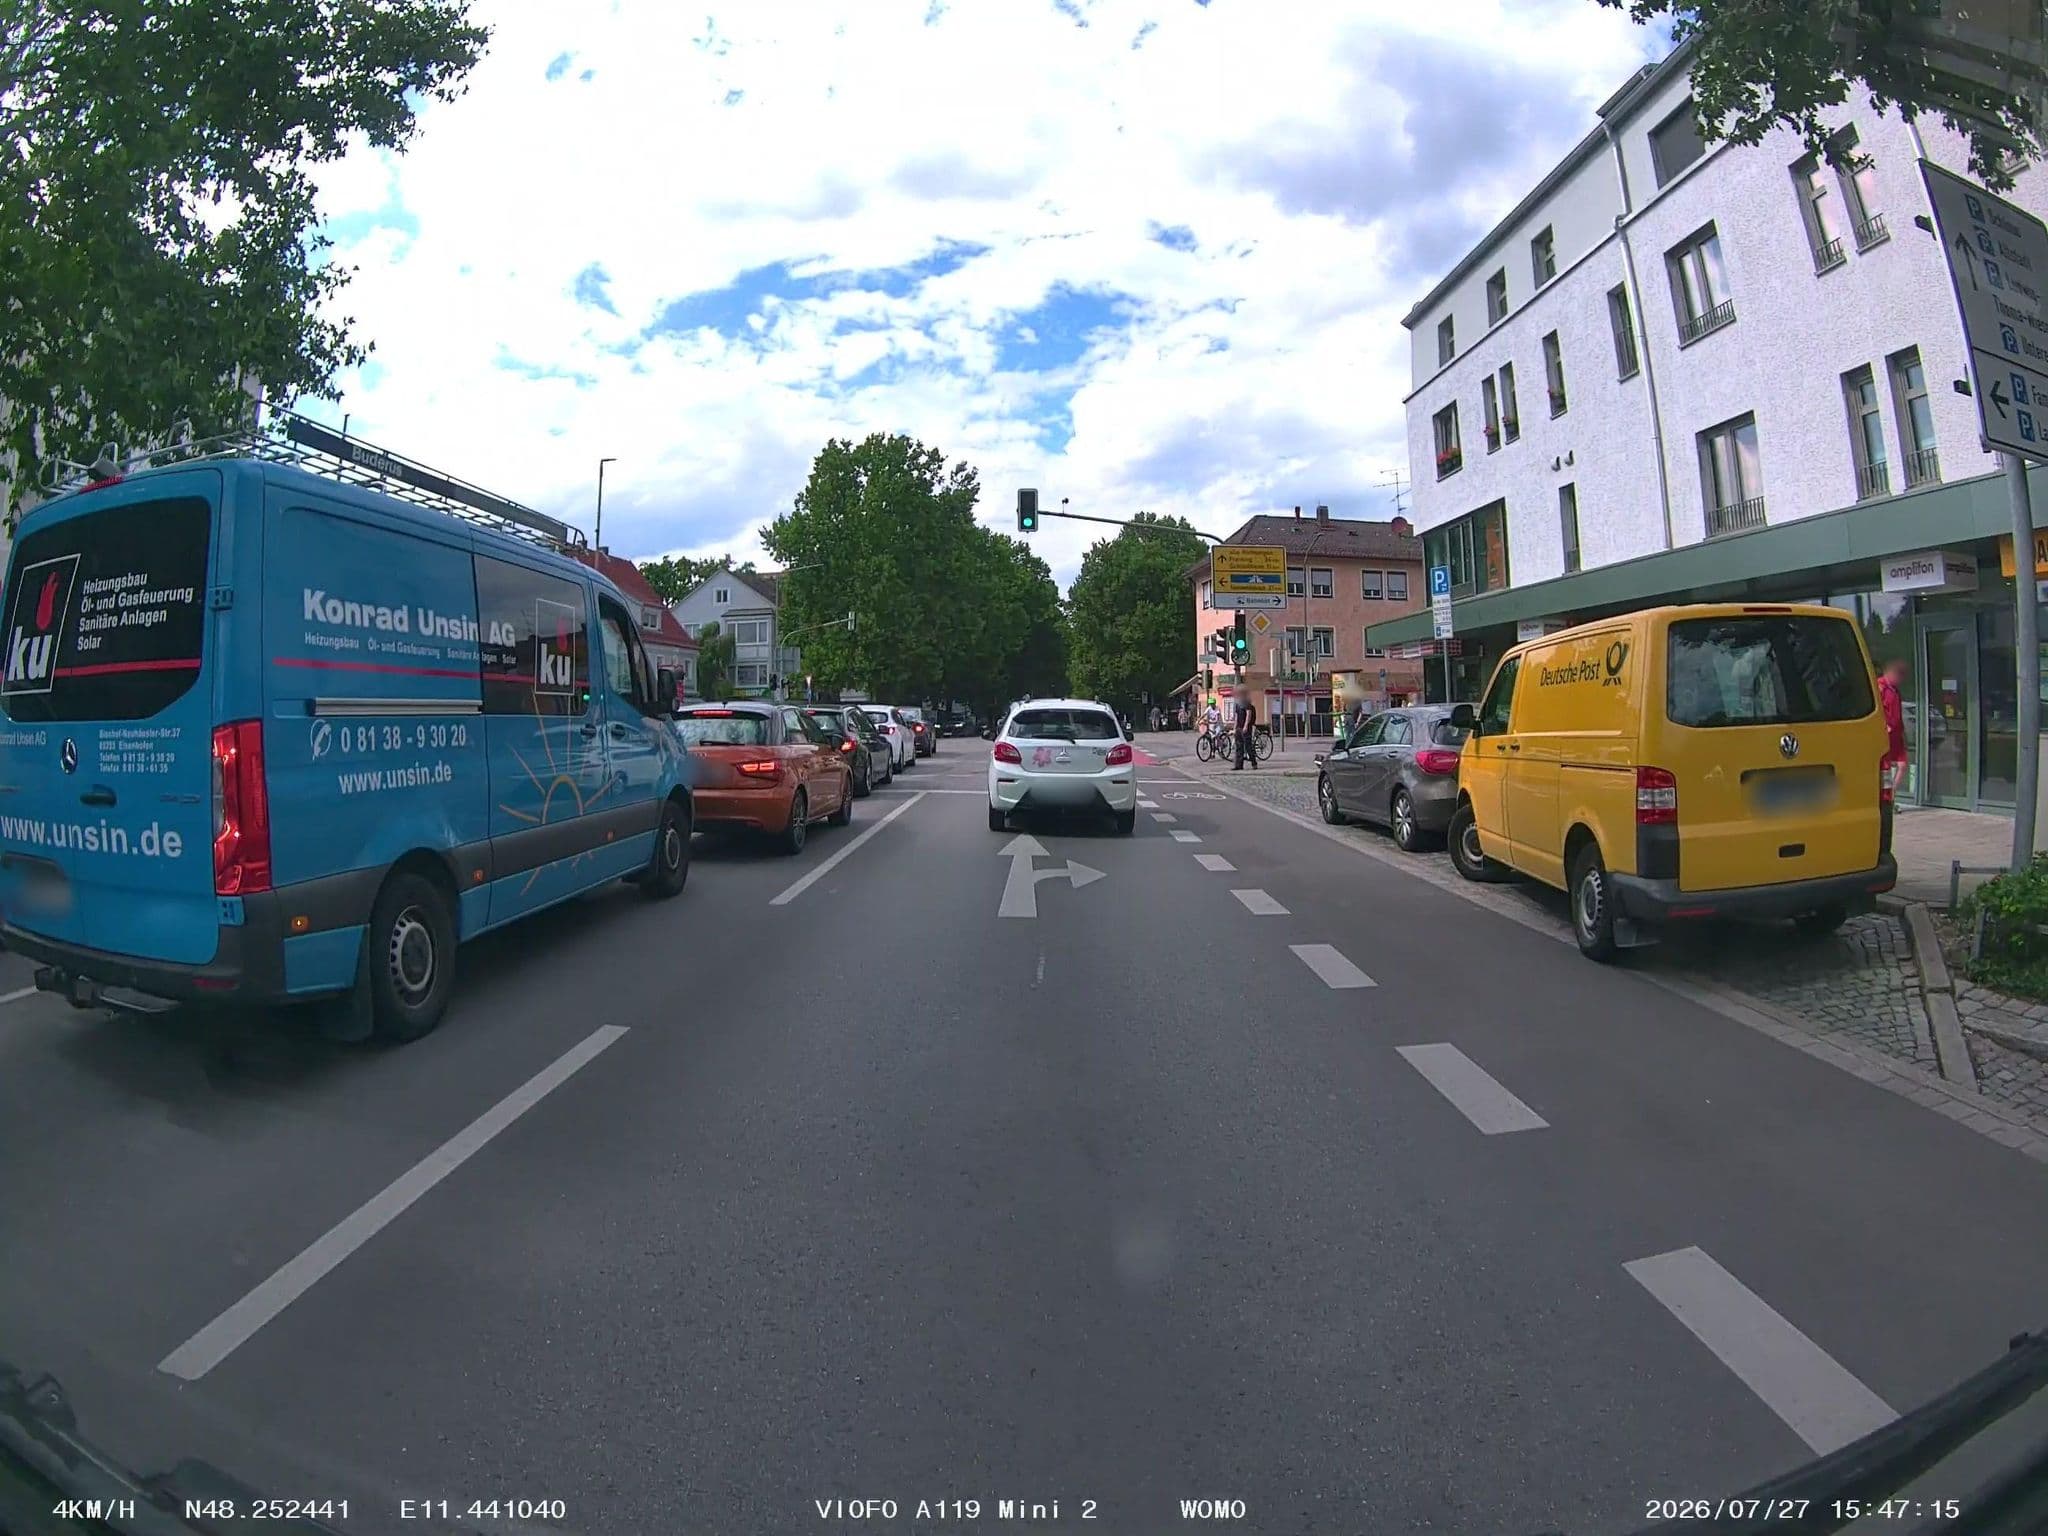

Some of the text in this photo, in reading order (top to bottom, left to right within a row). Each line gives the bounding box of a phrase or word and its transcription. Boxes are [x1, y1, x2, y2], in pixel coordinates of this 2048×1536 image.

[352, 445, 402, 476] Buderus
[2037, 539, 2048, 563] A
[83, 572, 148, 594] Heizungsbau
[1889, 561, 1934, 579] amplifon
[81, 587, 194, 613] Öl- und Gasfeuerung
[79, 608, 168, 632] Sanitäre Anlagen
[303, 588, 516, 648] Konrad Unsin AG
[8, 626, 52, 681] ku
[77, 636, 102, 651] Solar
[304, 632, 360, 650] Heizungsbau
[540, 643, 571, 686] ku
[1540, 660, 1600, 687] Deutsche Post
[340, 726, 350, 753] 0
[357, 726, 376, 753] 81
[382, 725, 401, 750] 38
[416, 724, 425, 748] 9
[430, 724, 446, 748] 30
[450, 724, 466, 747] 20
[338, 760, 452, 795] www.unsin.de
[0, 815, 183, 858] www.unsin.de
